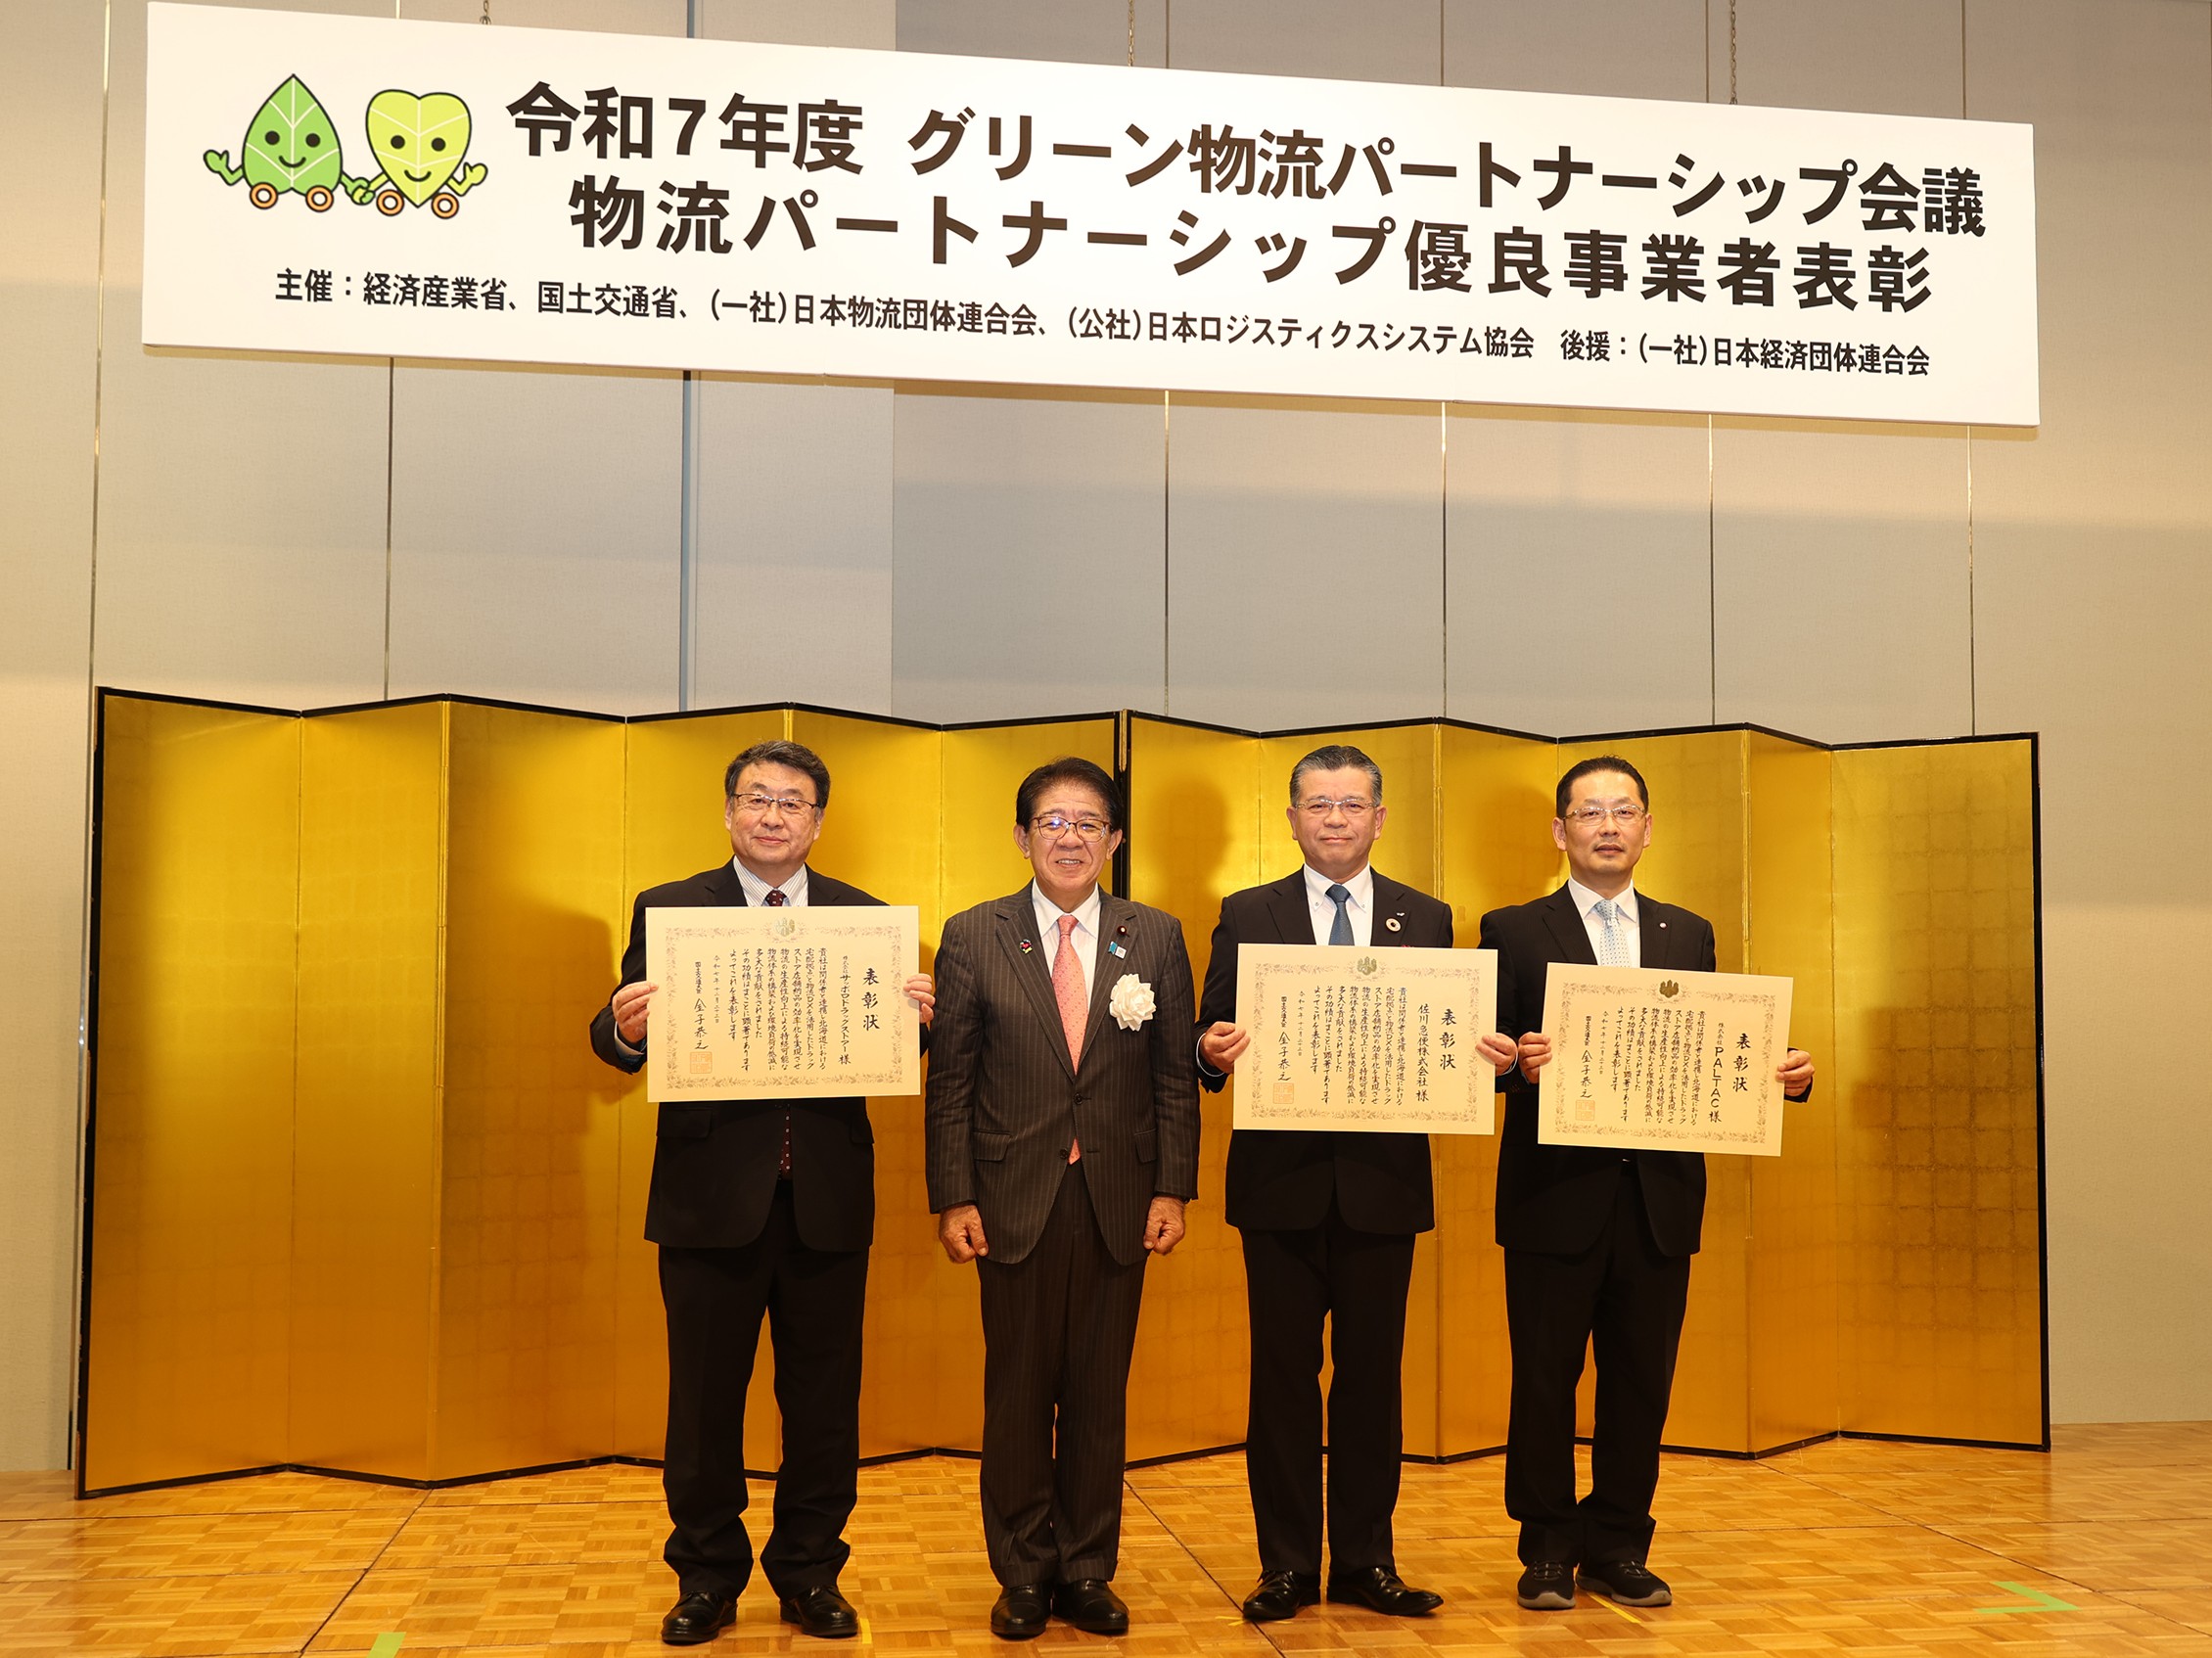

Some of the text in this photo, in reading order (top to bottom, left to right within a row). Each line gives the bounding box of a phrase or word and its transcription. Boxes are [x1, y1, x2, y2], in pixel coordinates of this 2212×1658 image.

[506, 81, 1985, 237] 令和7年度 グリーン物流パートナーシップ会議
[569, 175, 1931, 312] 物流パートナーシップ優良事業者表彰
[1561, 330, 1929, 376] 後援：(一社)日本経済団体連合会
[727, 949, 739, 1041] よってこれを表彰します
[861, 968, 879, 1032] 表彰状
[1311, 986, 1320, 1075] よってこれを表彰します
[1440, 1008, 1456, 1070] 表彰状
[1610, 1006, 1623, 1092] よってこれを表彰します
[1732, 1033, 1750, 1092] 表彰状
